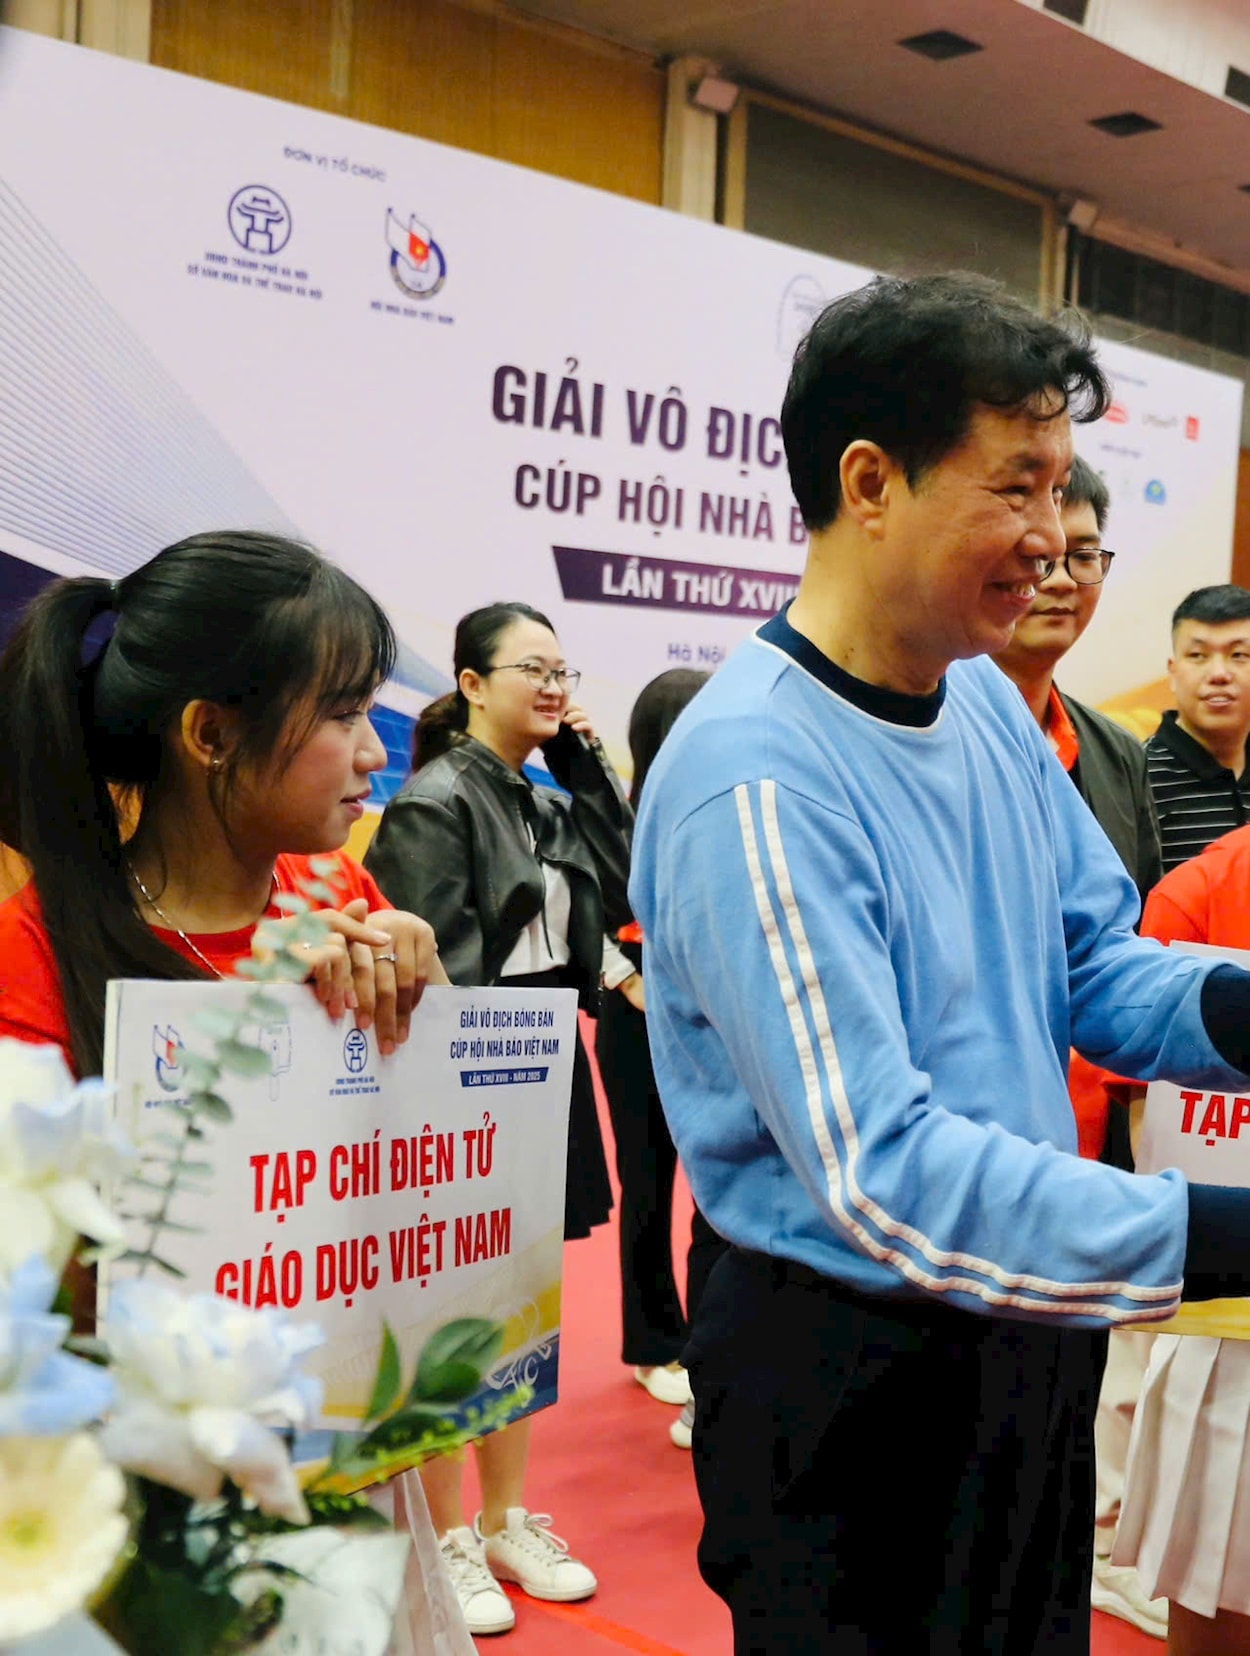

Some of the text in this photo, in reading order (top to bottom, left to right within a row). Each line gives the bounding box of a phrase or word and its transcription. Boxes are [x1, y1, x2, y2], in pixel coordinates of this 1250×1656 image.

[493, 356, 783, 478] GIẢI VÔ ĐỊC
[514, 459, 602, 516] CÚP
[618, 474, 684, 538] HỘI
[699, 491, 774, 543] NHÀ
[602, 557, 665, 599] LẦN
[672, 570, 735, 607] THỨ
[450, 1035, 559, 1062] CÚP HỘI NHÀ BÁO VIỆT NAM
[460, 1004, 478, 1028] GIẢI
[480, 1007, 491, 1028] VÔ
[493, 1010, 512, 1032] ĐỊCH
[514, 1007, 536, 1027] BÓNG
[249, 1111, 498, 1223] TẠP CHÍ ĐIỆN TỬ
[214, 1206, 512, 1312] GIÁO DỤC VIỆT NAM
